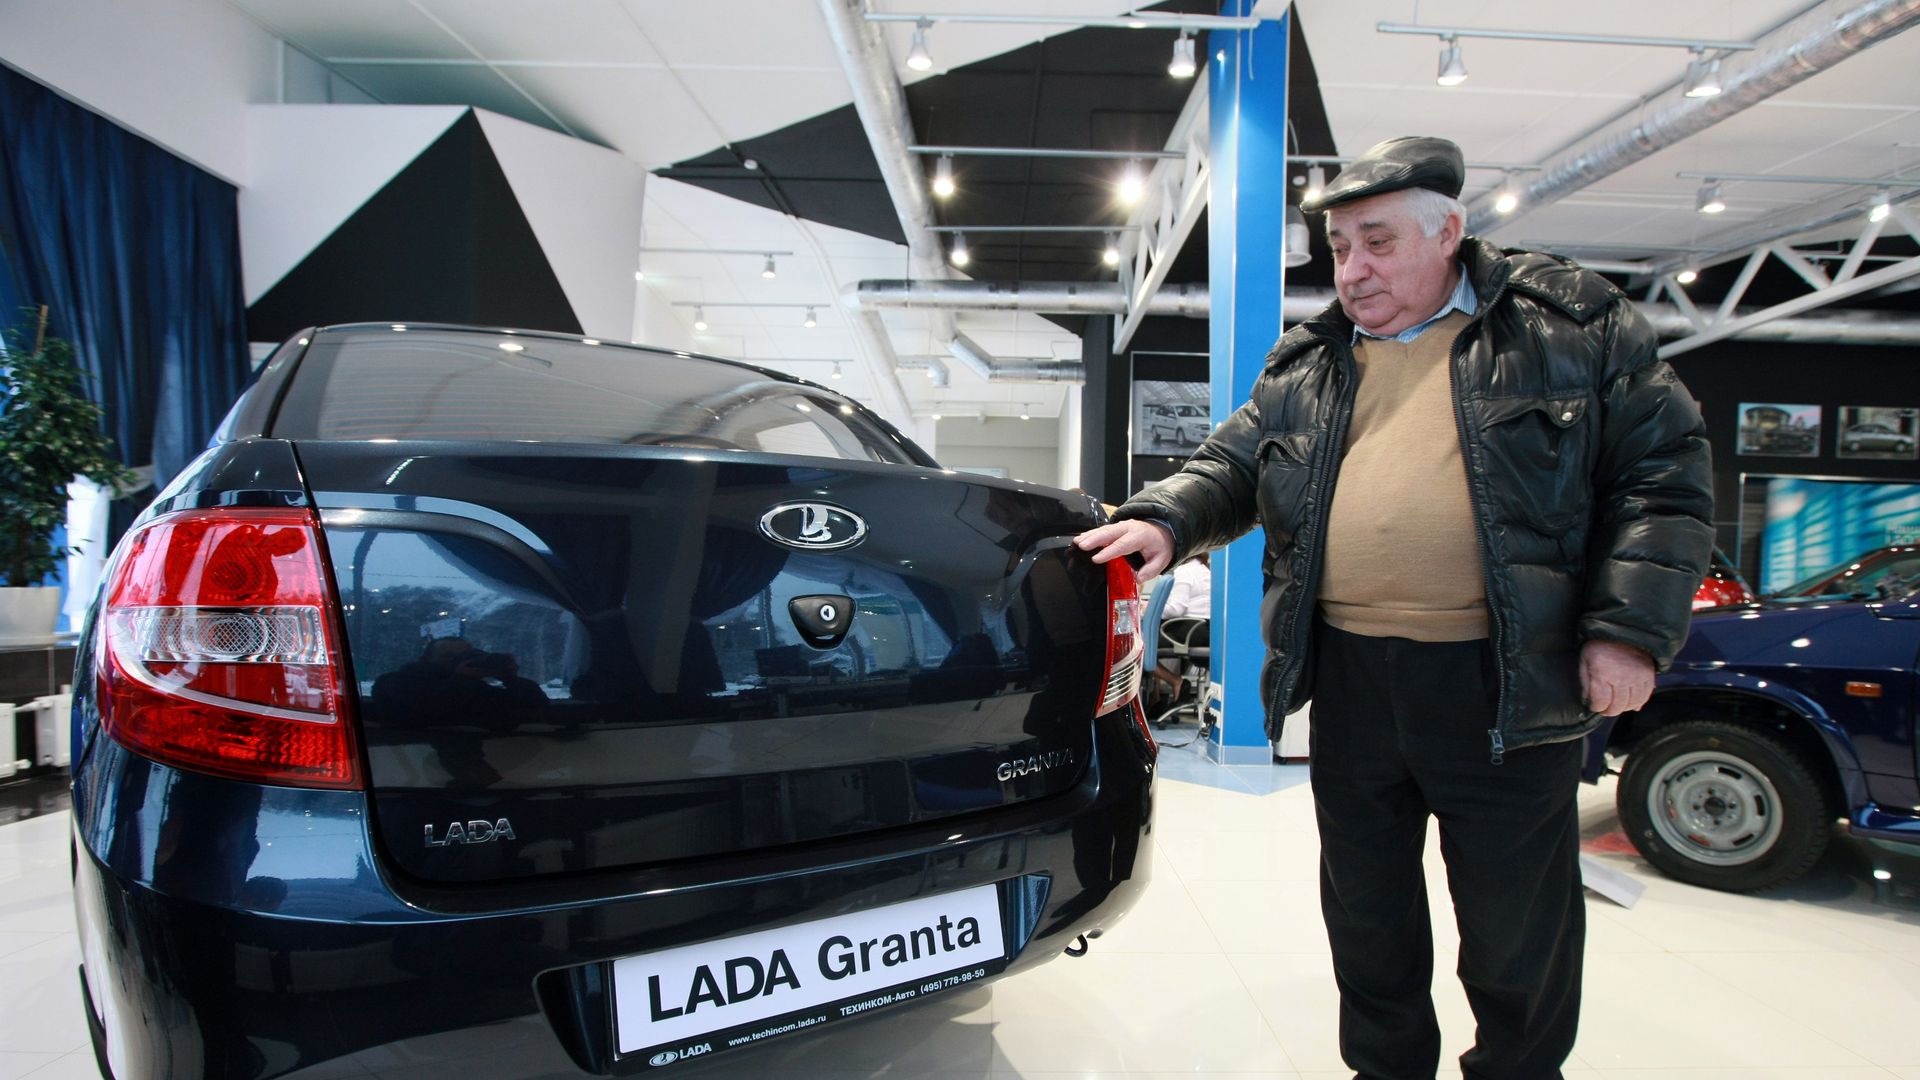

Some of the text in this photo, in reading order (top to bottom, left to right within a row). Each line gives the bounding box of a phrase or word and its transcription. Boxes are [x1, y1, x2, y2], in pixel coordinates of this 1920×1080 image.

[996, 747, 1074, 781] GRANTA
[424, 818, 516, 848] LADA
[648, 914, 982, 1022] LADA Granta
[840, 968, 985, 1016] ТЕХИНКОМ-Авто (495) 778-98-50
[728, 1015, 827, 1046] www.techincom.lada.ru
[679, 1042, 712, 1059] LADA
